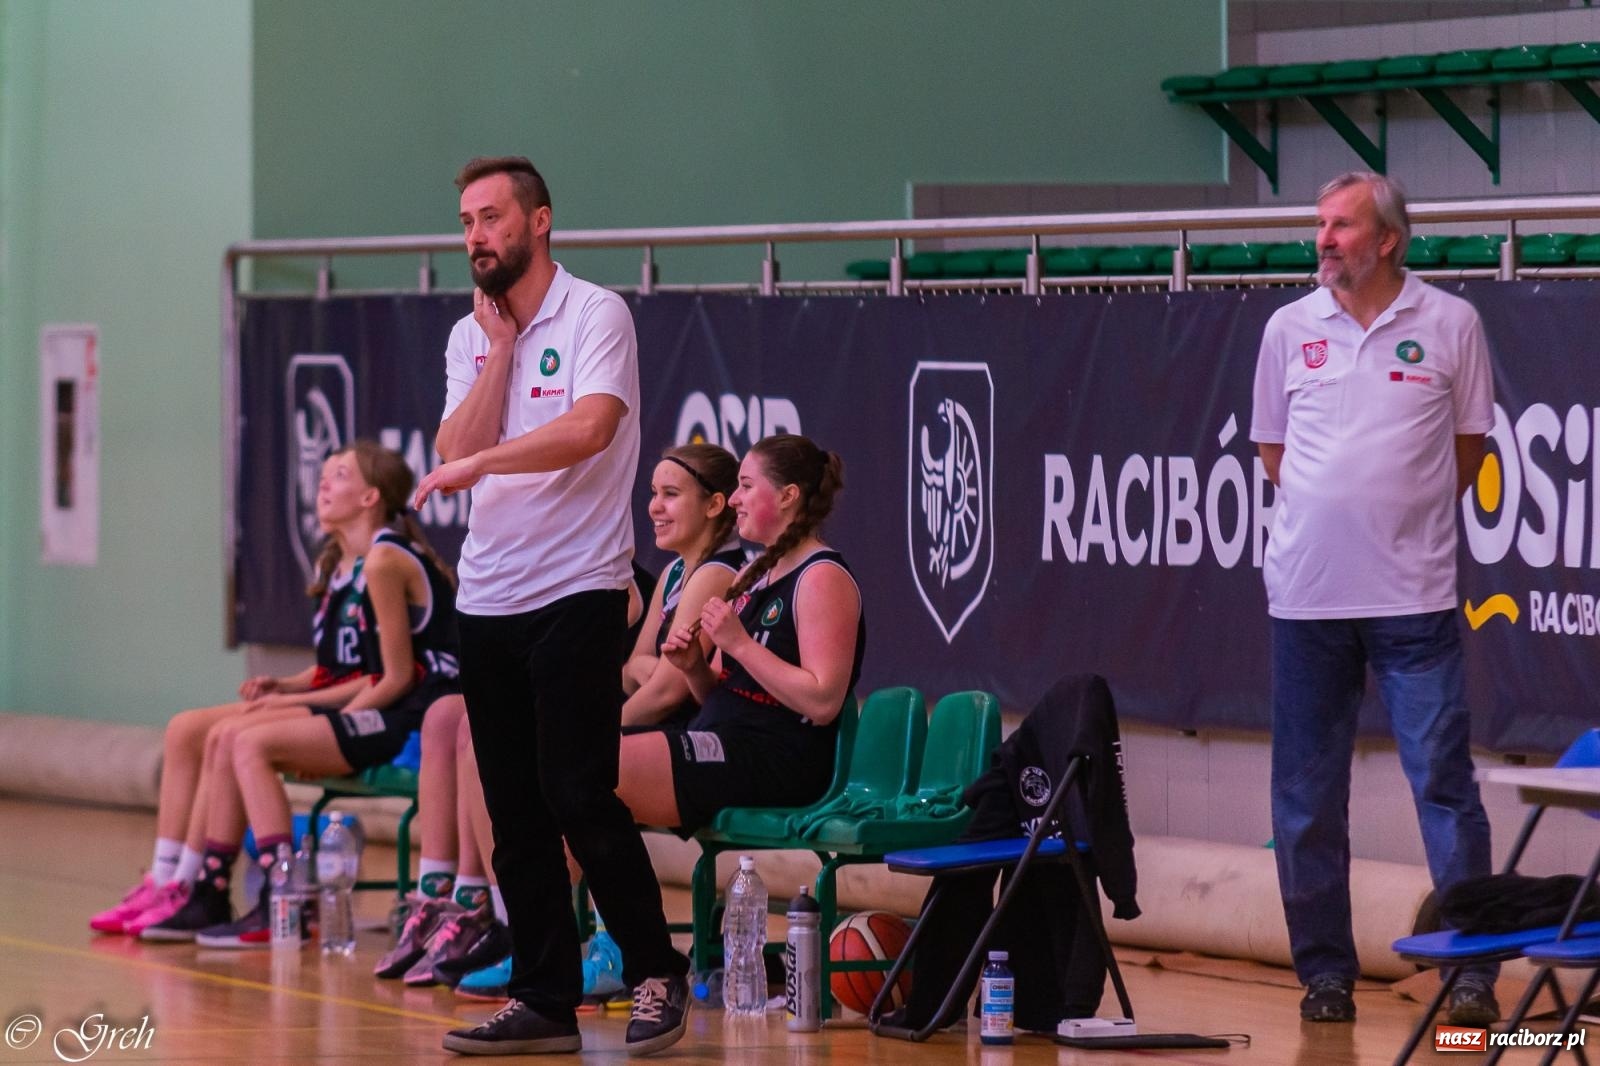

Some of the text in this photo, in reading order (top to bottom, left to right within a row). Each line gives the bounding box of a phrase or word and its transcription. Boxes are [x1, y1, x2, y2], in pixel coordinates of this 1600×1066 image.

[1041, 412, 1281, 569] RACIBÓR
[1462, 402, 1600, 568] OSi
[336, 626, 362, 665] 12
